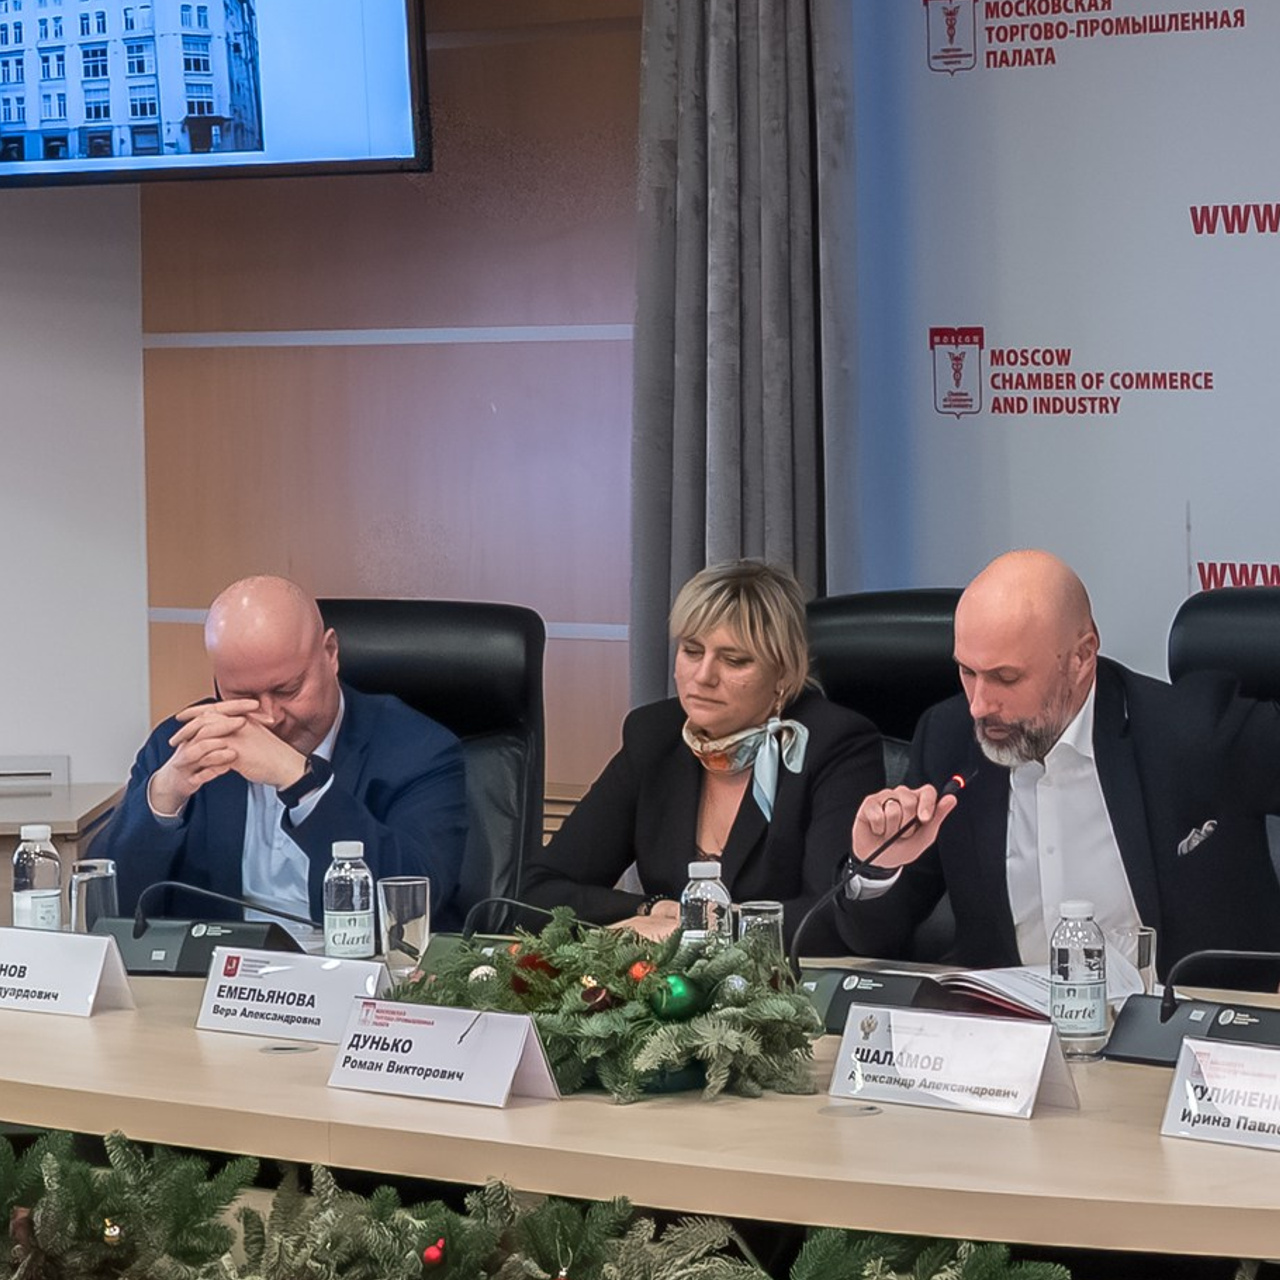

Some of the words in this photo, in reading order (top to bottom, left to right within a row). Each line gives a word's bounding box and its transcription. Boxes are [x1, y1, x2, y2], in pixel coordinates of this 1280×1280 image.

[985, 9, 1245, 44] ТОРГОВО-ПРОМЫШЛЕННАЯ
[986, 47, 1056, 68] ПАЛАТА
[989, 349, 1071, 367] MOSCOW
[990, 373, 1076, 391] CHAMBER
[1081, 373, 1104, 390] OF
[1110, 372, 1213, 390] COMMERCE
[990, 397, 1028, 415] AND
[1033, 396, 1121, 414] INDUSTRY
[216, 984, 317, 1009] ЕМЕЛЬЯНОВА
[212, 1004, 238, 1019] Вера
[240, 1006, 322, 1027] Александровна
[347, 1033, 414, 1055] ДУНЬКО
[341, 1055, 384, 1072] Роман
[386, 1060, 465, 1082] Викторович
[847, 1070, 916, 1089] Аександр
[917, 1077, 1020, 1100] Александрович
[1180, 1108, 1232, 1128] Ирина
